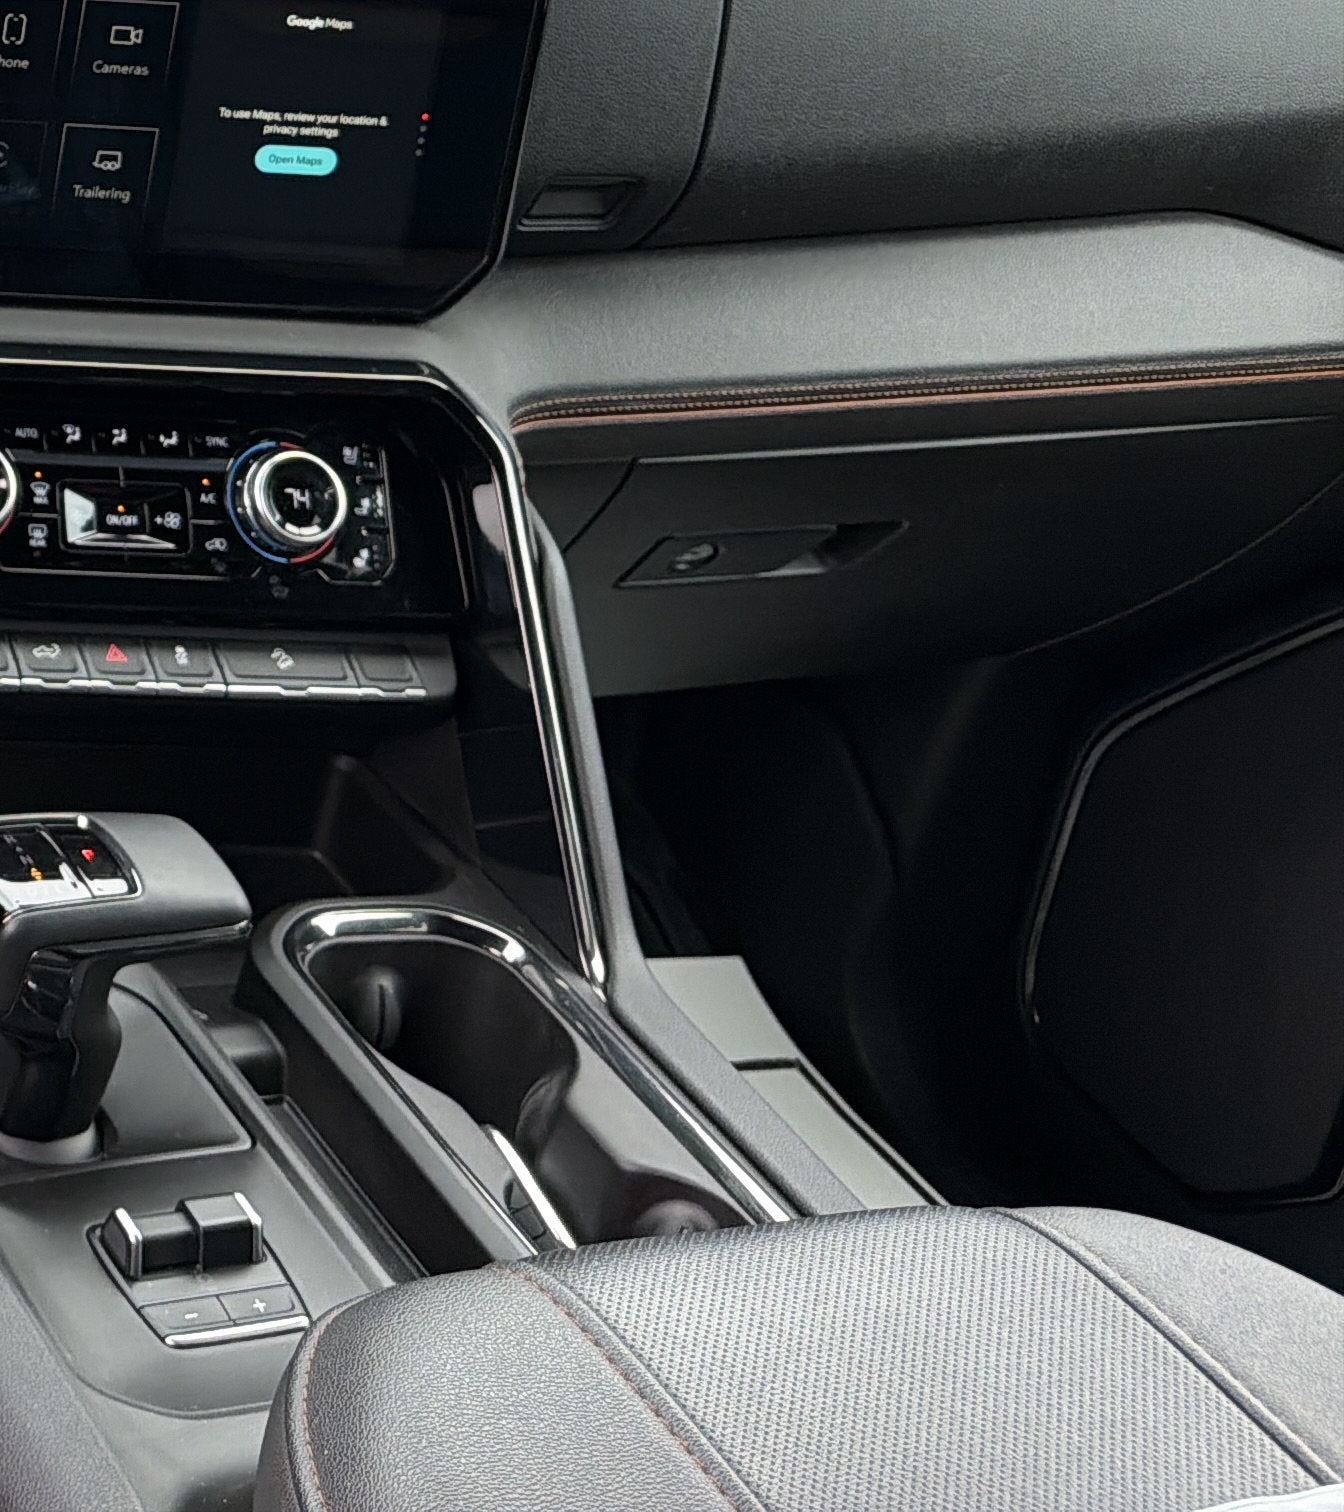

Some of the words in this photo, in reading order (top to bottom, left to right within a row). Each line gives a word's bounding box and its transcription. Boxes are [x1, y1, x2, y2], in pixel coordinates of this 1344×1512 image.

[286, 14, 326, 31] Google
[325, 18, 354, 31] Maps
[92, 60, 150, 77] Cameras
[219, 107, 231, 119] To
[233, 110, 251, 120] use
[283, 112, 314, 123] review
[317, 114, 338, 125] your
[340, 113, 376, 126] location
[379, 116, 388, 127] &
[263, 125, 298, 137] privacy
[300, 127, 339, 139] settings
[269, 154, 294, 166] Open
[296, 155, 323, 168] Maps
[72, 184, 131, 203] Trailering
[14, 427, 39, 438] AUTO
[205, 436, 230, 448] SYNC
[199, 492, 217, 505] A/C
[284, 488, 311, 510] 74
[105, 514, 139, 526] ON/OFF
